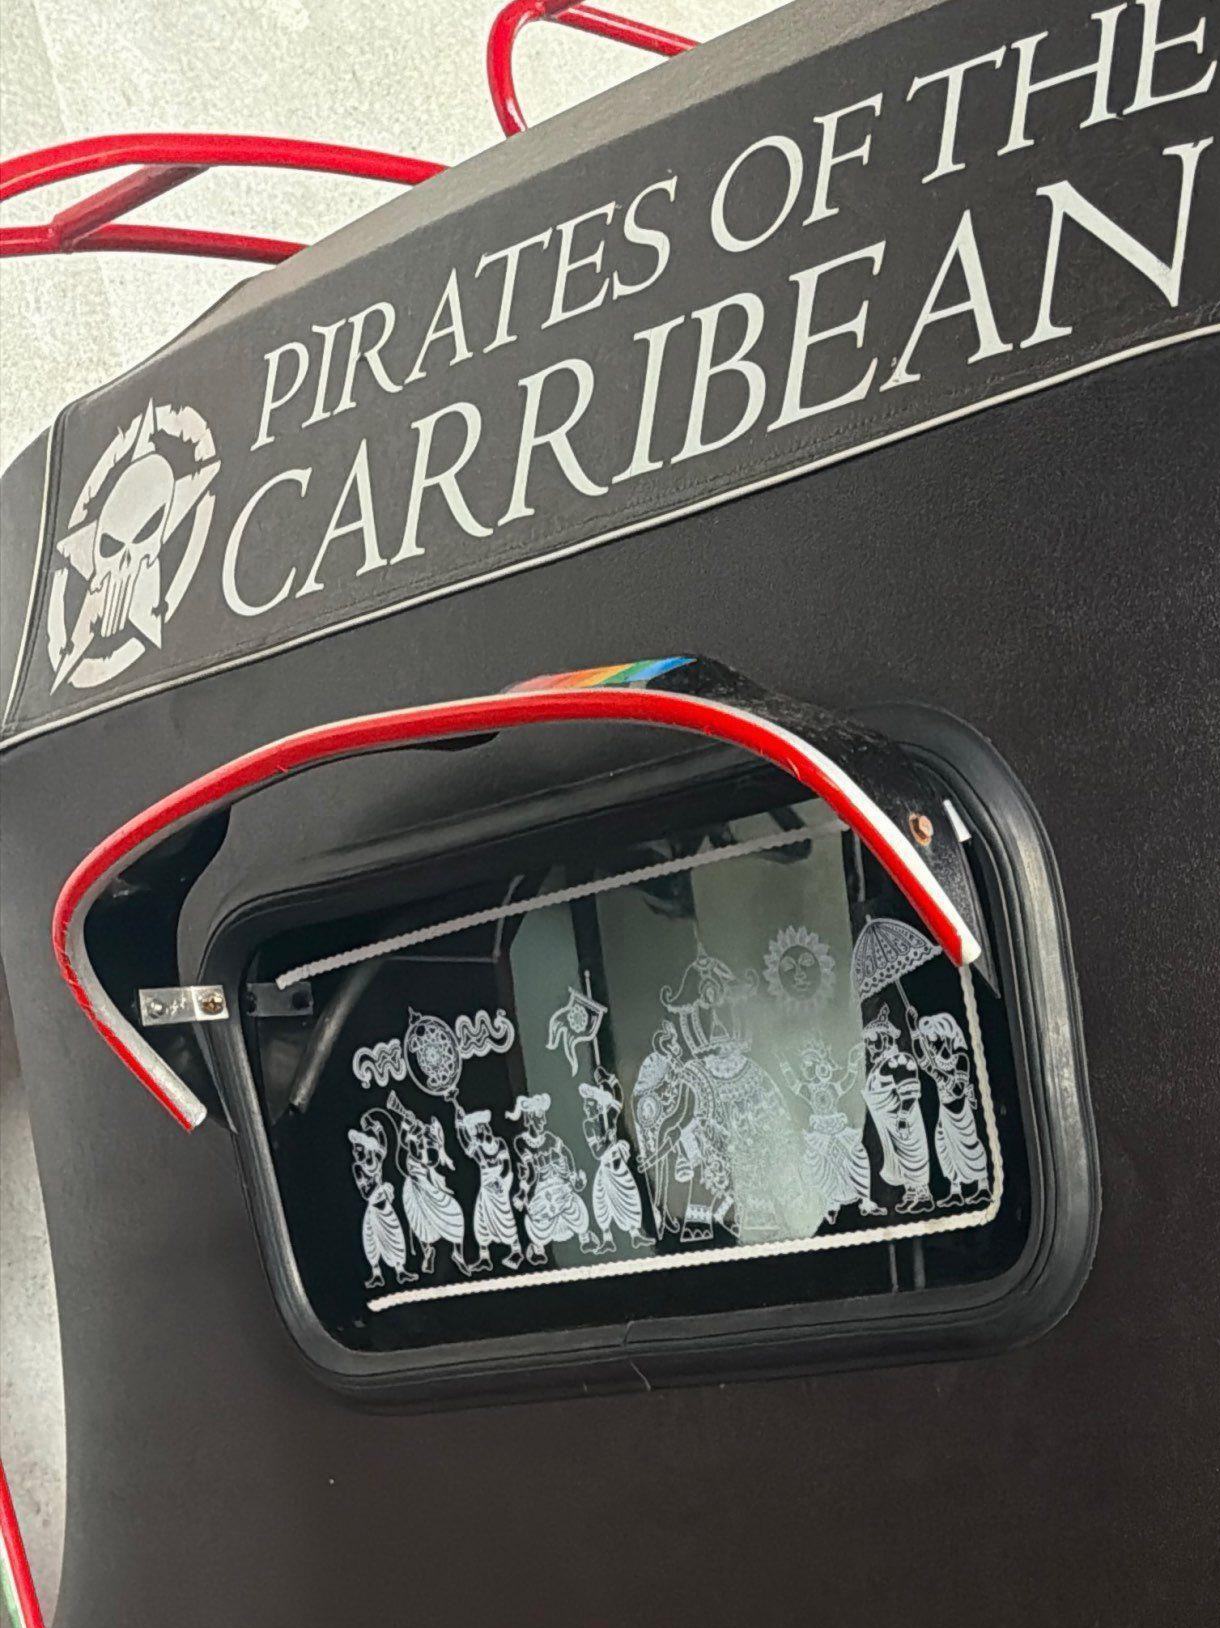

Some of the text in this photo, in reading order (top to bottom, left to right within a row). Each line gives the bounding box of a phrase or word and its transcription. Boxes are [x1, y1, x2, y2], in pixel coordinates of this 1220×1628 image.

[221, 136, 1215, 617] CARRIBEAN
[250, 0, 1219, 450] PIRATES OF THE
